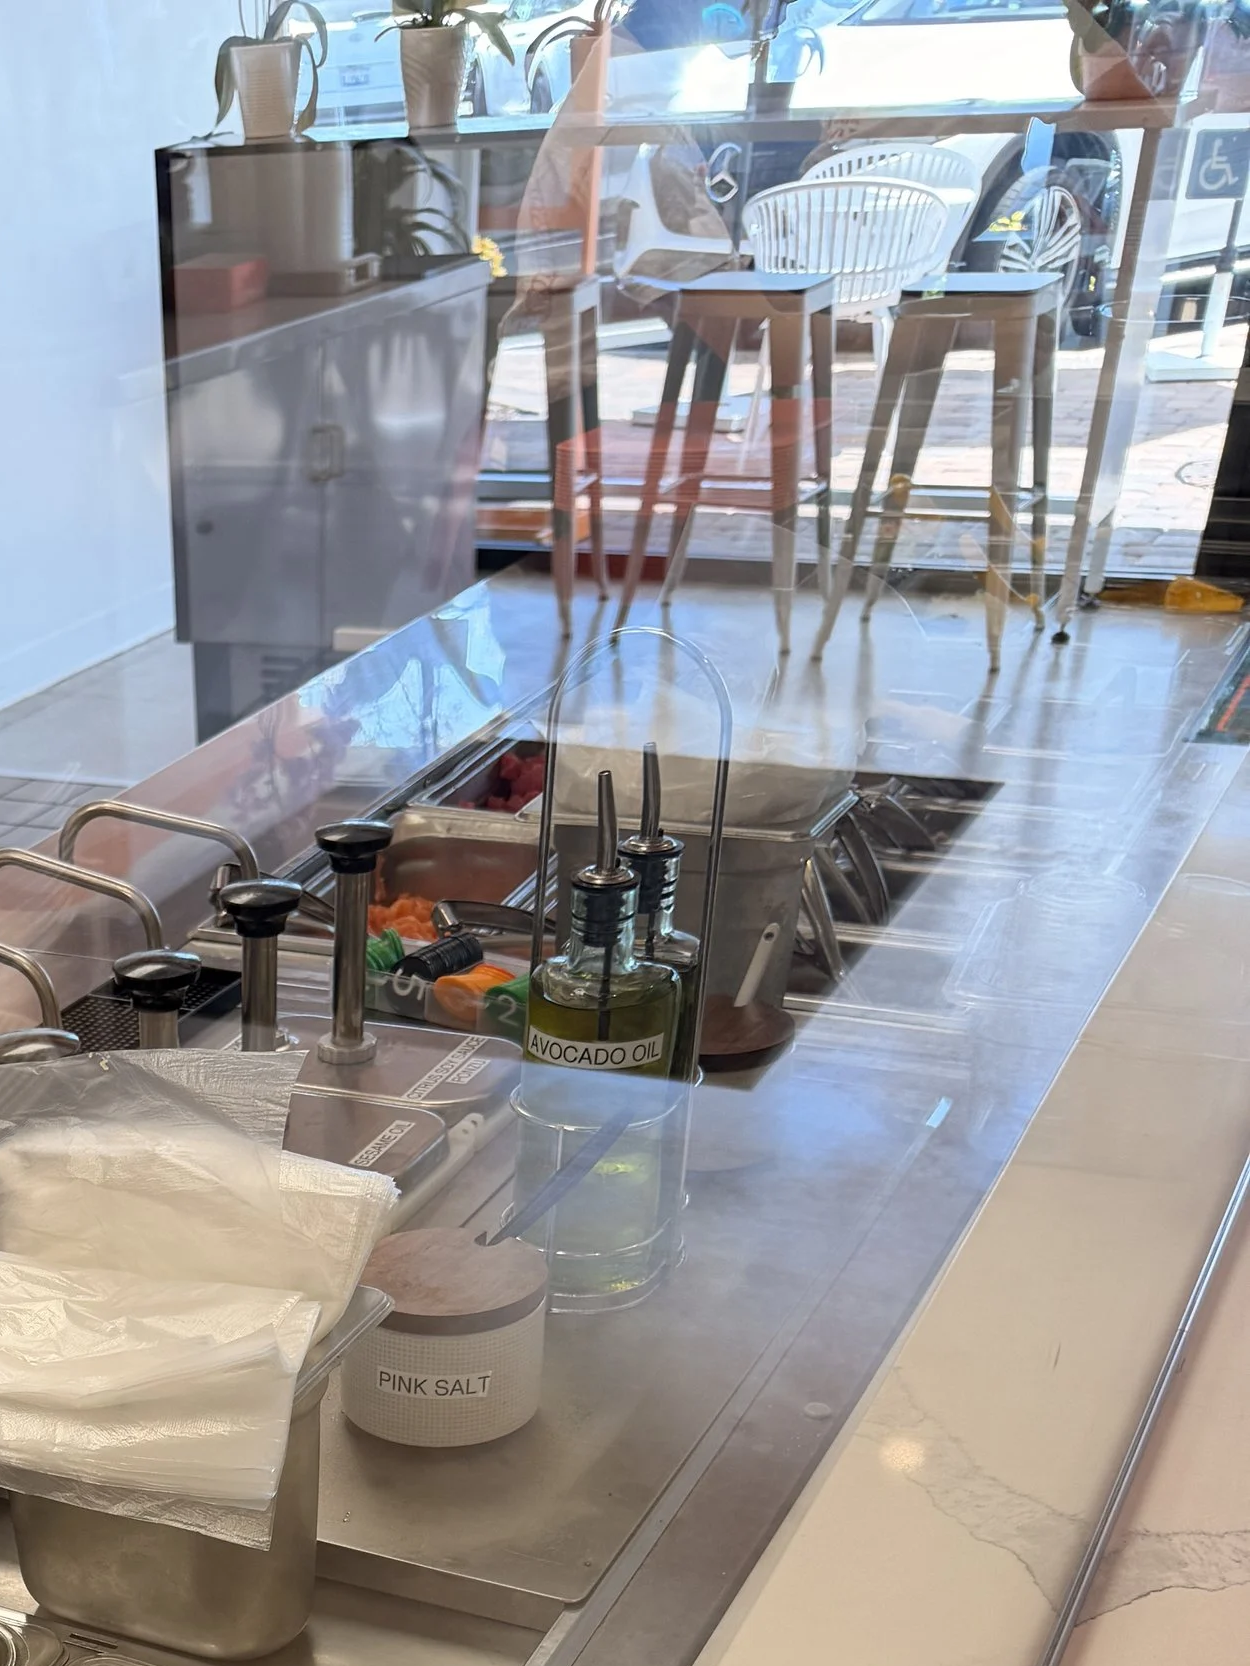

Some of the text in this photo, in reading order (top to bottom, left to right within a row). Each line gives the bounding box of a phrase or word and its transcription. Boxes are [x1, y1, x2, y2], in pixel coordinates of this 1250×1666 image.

[530, 1034, 659, 1066] AVOCADO OIL
[406, 1036, 485, 1100] CITRUS SOY SAUCE
[452, 1058, 487, 1084] PONZU
[354, 1121, 412, 1167] SESAME OIL
[379, 1371, 490, 1396] PINK SALT
